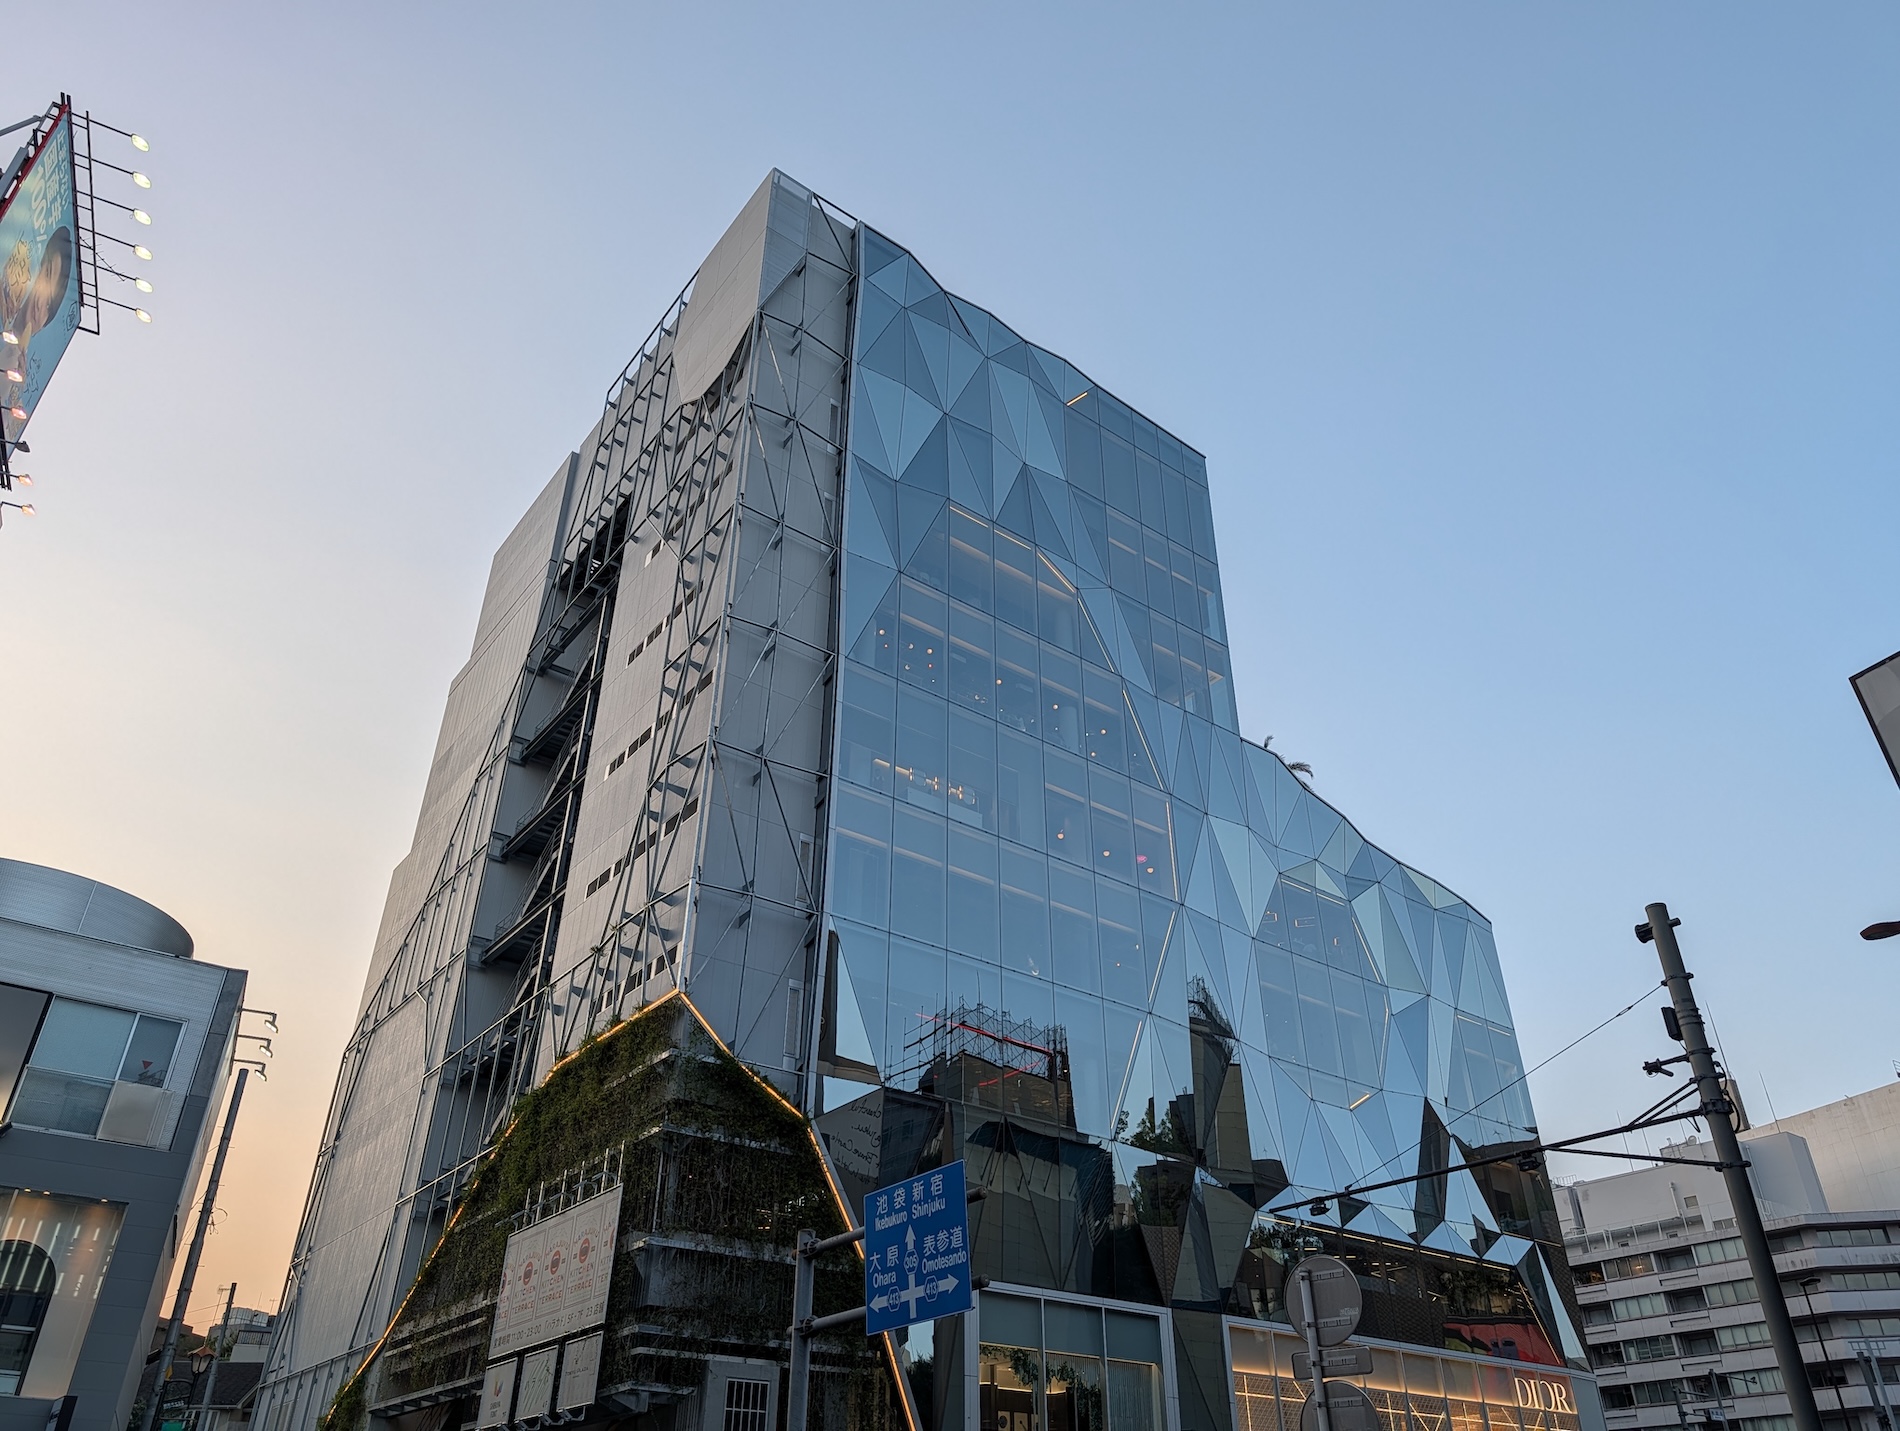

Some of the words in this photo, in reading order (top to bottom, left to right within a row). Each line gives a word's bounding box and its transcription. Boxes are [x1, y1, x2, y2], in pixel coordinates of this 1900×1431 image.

[43, 138, 61, 230] 国産芋
[874, 1213, 908, 1232] Ikebukuro
[912, 1197, 946, 1220] Shinjuku
[922, 1226, 964, 1258] 表参道
[869, 1244, 900, 1274] 大原
[905, 1255, 918, 1269] 305
[921, 1248, 967, 1274] Omotesando
[570, 1261, 594, 1277] KITCHEN
[541, 1274, 564, 1289] KITCHEN
[567, 1279, 593, 1295] TERRACE
[873, 1271, 897, 1288] Ohara
[926, 1282, 938, 1295] 413
[540, 1290, 563, 1305] TERRACE
[888, 1291, 900, 1303] 413
[512, 1301, 535, 1315] TERRACE
[1514, 1377, 1573, 1414] DIOR
